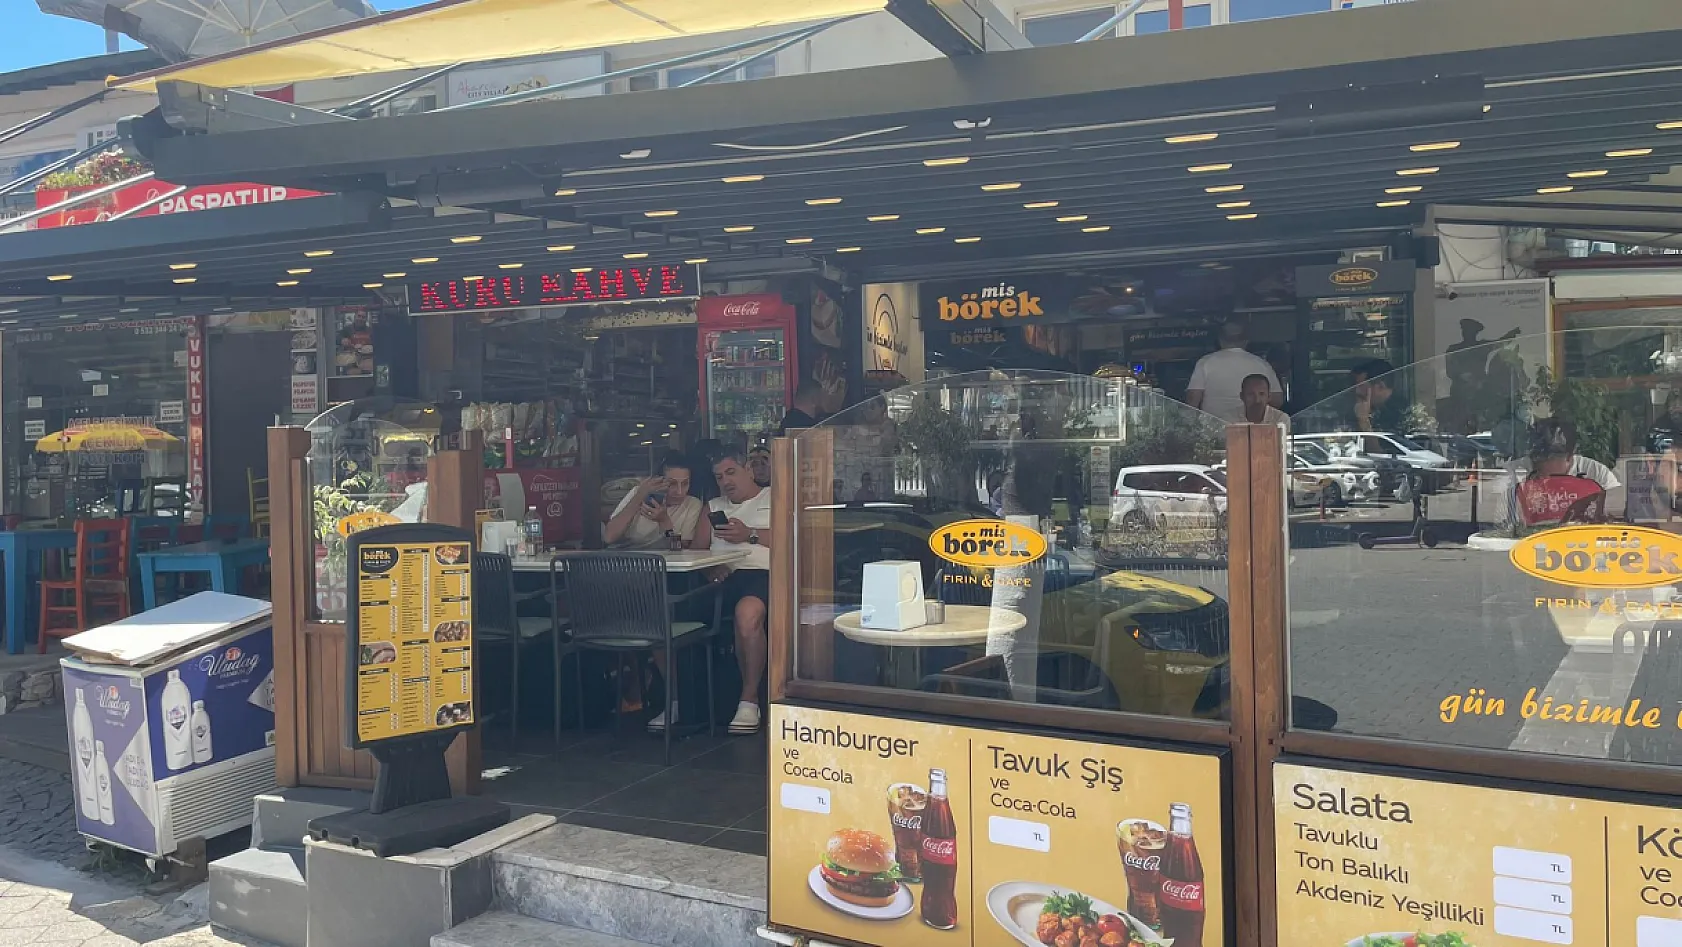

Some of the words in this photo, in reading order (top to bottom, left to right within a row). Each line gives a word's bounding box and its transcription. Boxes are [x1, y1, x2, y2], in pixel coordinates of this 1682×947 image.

[982, 283, 1015, 298] mis
[938, 291, 1044, 321] börek
[951, 330, 1006, 346] börek
[980, 525, 1005, 538] mis
[943, 532, 1031, 557] börek
[1595, 532, 1641, 549] mis
[1533, 542, 1682, 574] börek
[1535, 597, 1592, 609] FIRIN
[1440, 688, 1505, 723] gün
[1520, 687, 1661, 729] bizimle
[782, 719, 919, 758] Hamburger
[783, 747, 799, 759] ve
[987, 745, 1070, 779] Tavuk
[1080, 757, 1124, 792] Şiş
[990, 777, 1010, 790] ve
[817, 796, 826, 805] TL
[1293, 783, 1413, 824] Salata
[1033, 832, 1044, 841] TL
[1294, 823, 1378, 850] Tavuklu
[1294, 850, 1334, 872] Ton
[1343, 858, 1409, 884] Balıklı
[1550, 863, 1565, 873] TL
[1640, 865, 1672, 883] ve
[1296, 879, 1385, 909] Akdeniz
[1392, 893, 1485, 926] Yeşillikli
[1551, 894, 1565, 904] TL
[1552, 924, 1566, 934] TL
